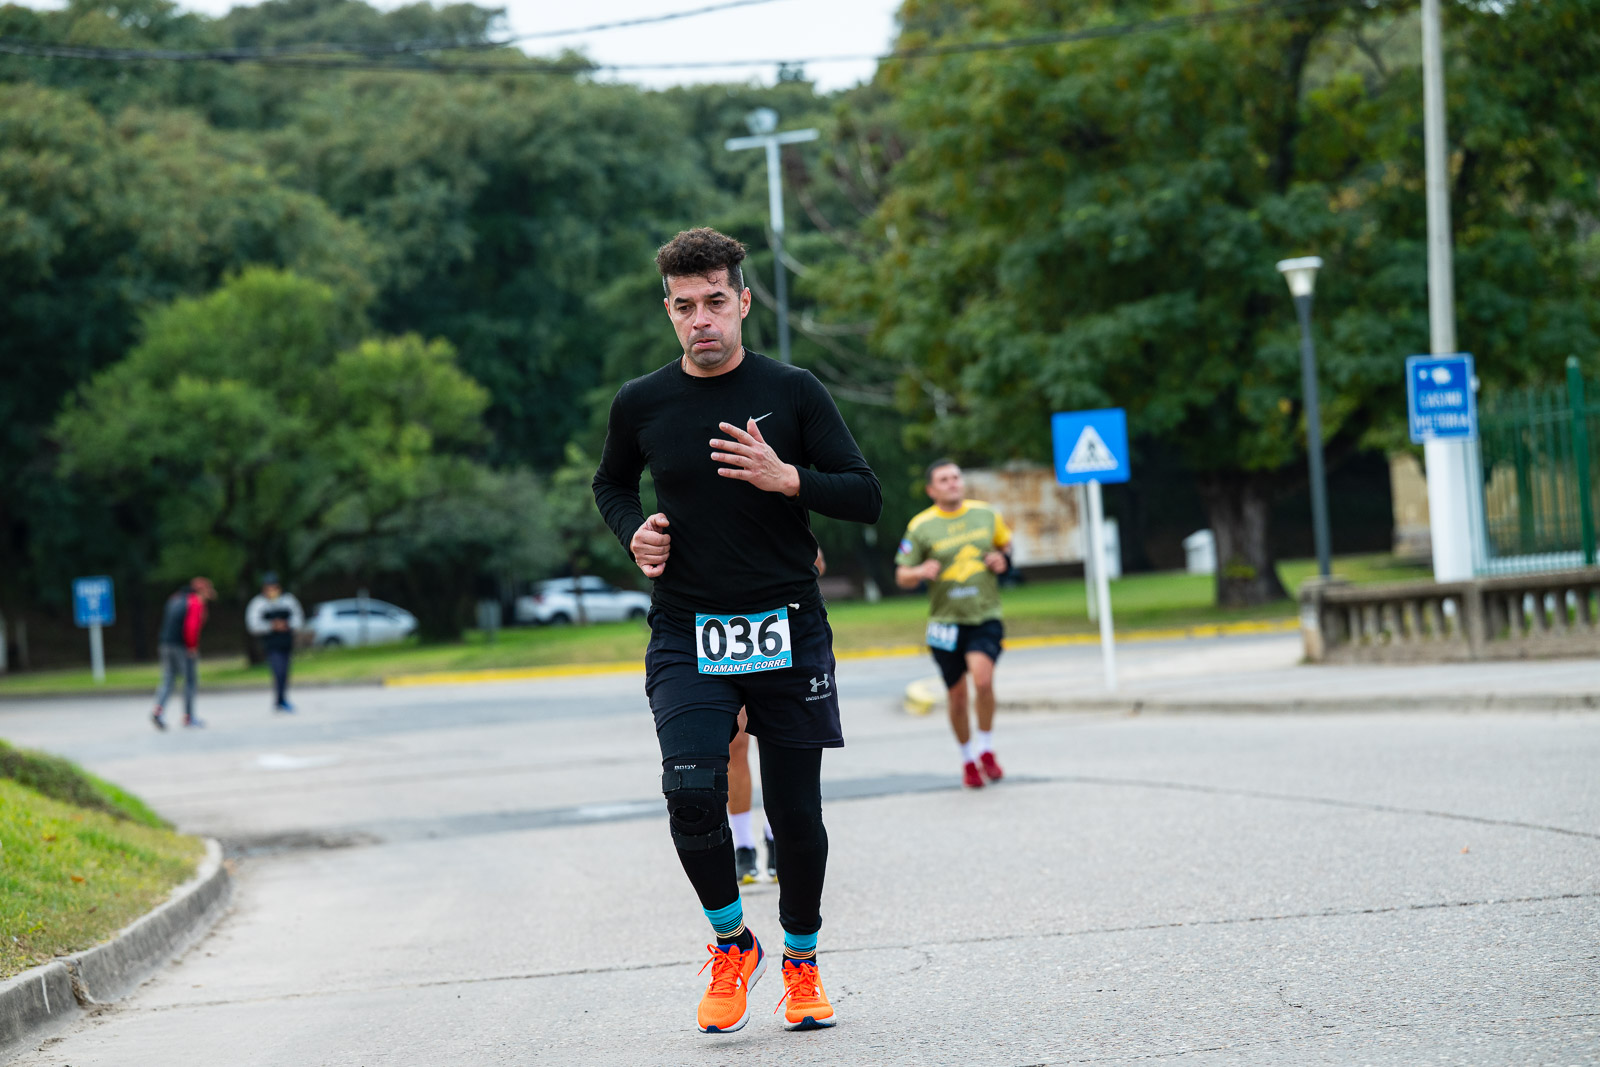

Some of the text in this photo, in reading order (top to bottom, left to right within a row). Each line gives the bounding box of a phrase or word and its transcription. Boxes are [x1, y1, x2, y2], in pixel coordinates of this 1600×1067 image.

[702, 613, 783, 662] 036
[703, 658, 787, 672] DIAMANTE CORRE
